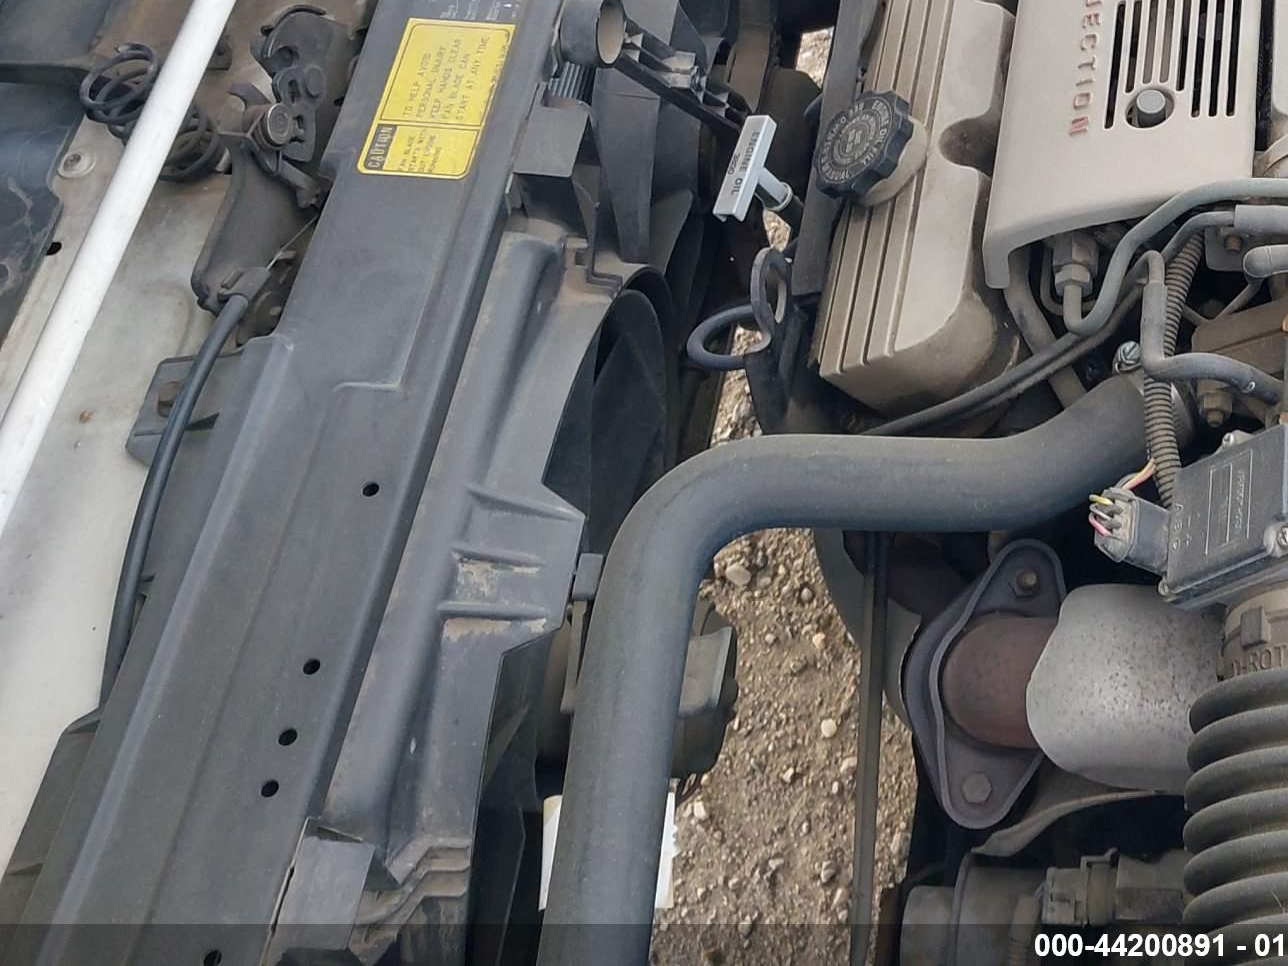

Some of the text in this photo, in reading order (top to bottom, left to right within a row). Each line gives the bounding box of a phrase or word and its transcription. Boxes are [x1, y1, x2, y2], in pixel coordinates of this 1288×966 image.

[403, 52, 432, 116] TO HELP AVOID
[416, 76, 437, 118] PERSONAL
[429, 98, 441, 119] KEEP
[439, 67, 453, 94] HANDS
[441, 53, 470, 120] FAN BLADE CAN
[455, 95, 469, 120] START
[471, 59, 482, 75] ANY
[478, 36, 491, 55] TIME
[872, 100, 890, 127] ENGINE
[367, 125, 393, 168] CAUTION
[403, 135, 416, 154] BLADE
[739, 131, 760, 173] ENGINE
[731, 177, 744, 196] OIL
